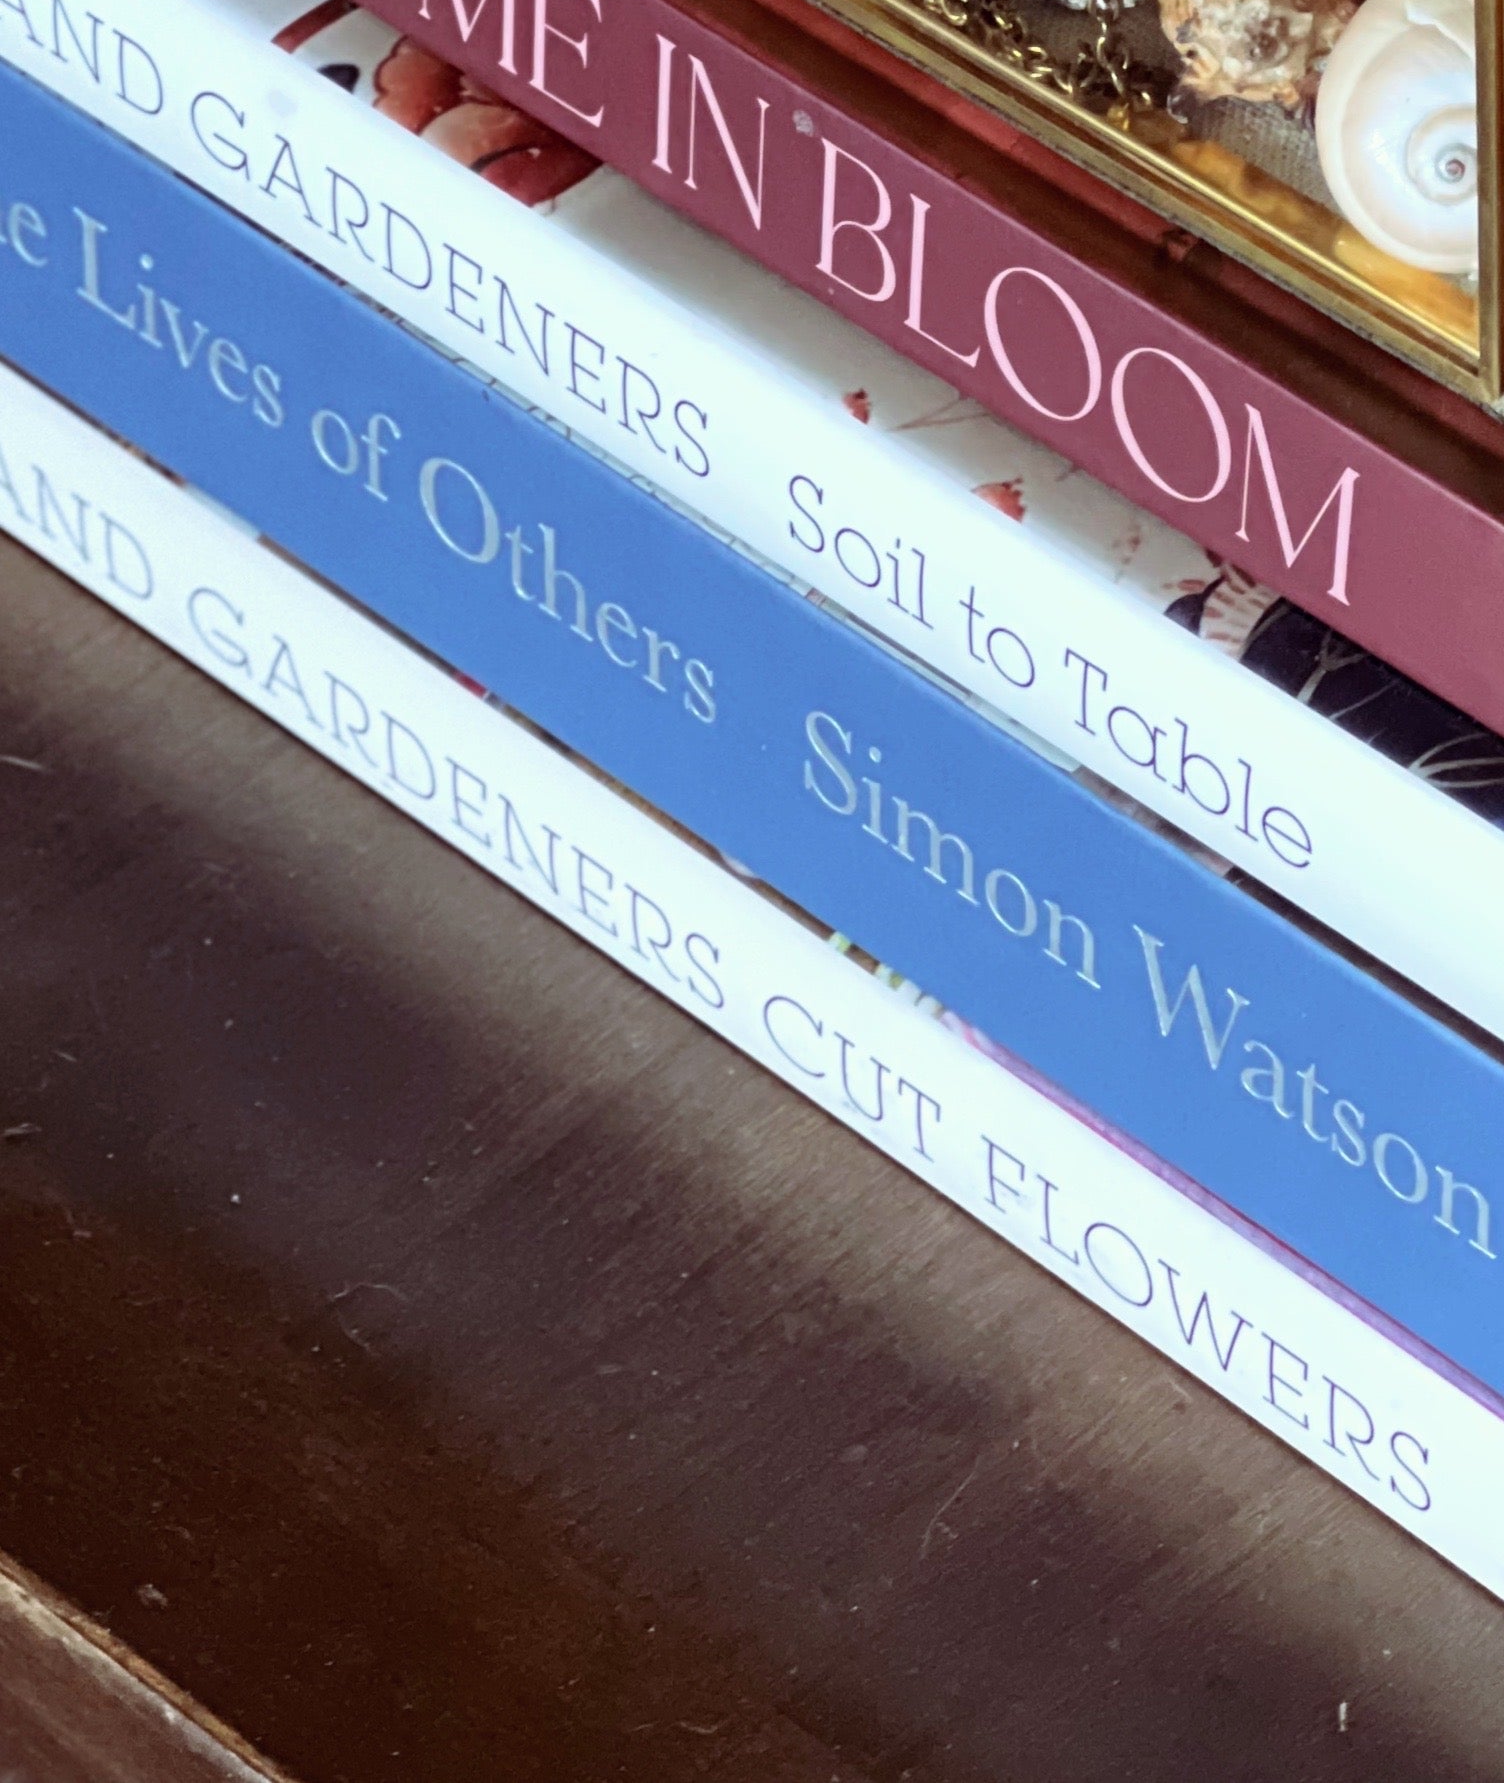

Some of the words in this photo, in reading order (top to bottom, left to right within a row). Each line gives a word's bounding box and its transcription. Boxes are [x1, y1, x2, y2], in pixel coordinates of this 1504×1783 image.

[72, 206, 284, 428] Lives
[311, 409, 401, 503] of
[419, 456, 718, 724] Others
[803, 710, 1102, 990] Simon
[1134, 923, 1498, 1259] Watson
[190, 90, 711, 478] GARDENERS
[787, 474, 933, 629] Soil
[960, 585, 1036, 690] to
[1063, 647, 1313, 870] Table
[652, 33, 770, 232] IN
[815, 137, 1361, 606] BLOOM
[186, 586, 725, 1010] GARDENERS
[763, 996, 942, 1165] CUT
[981, 1134, 1431, 1513] FLOWERS
